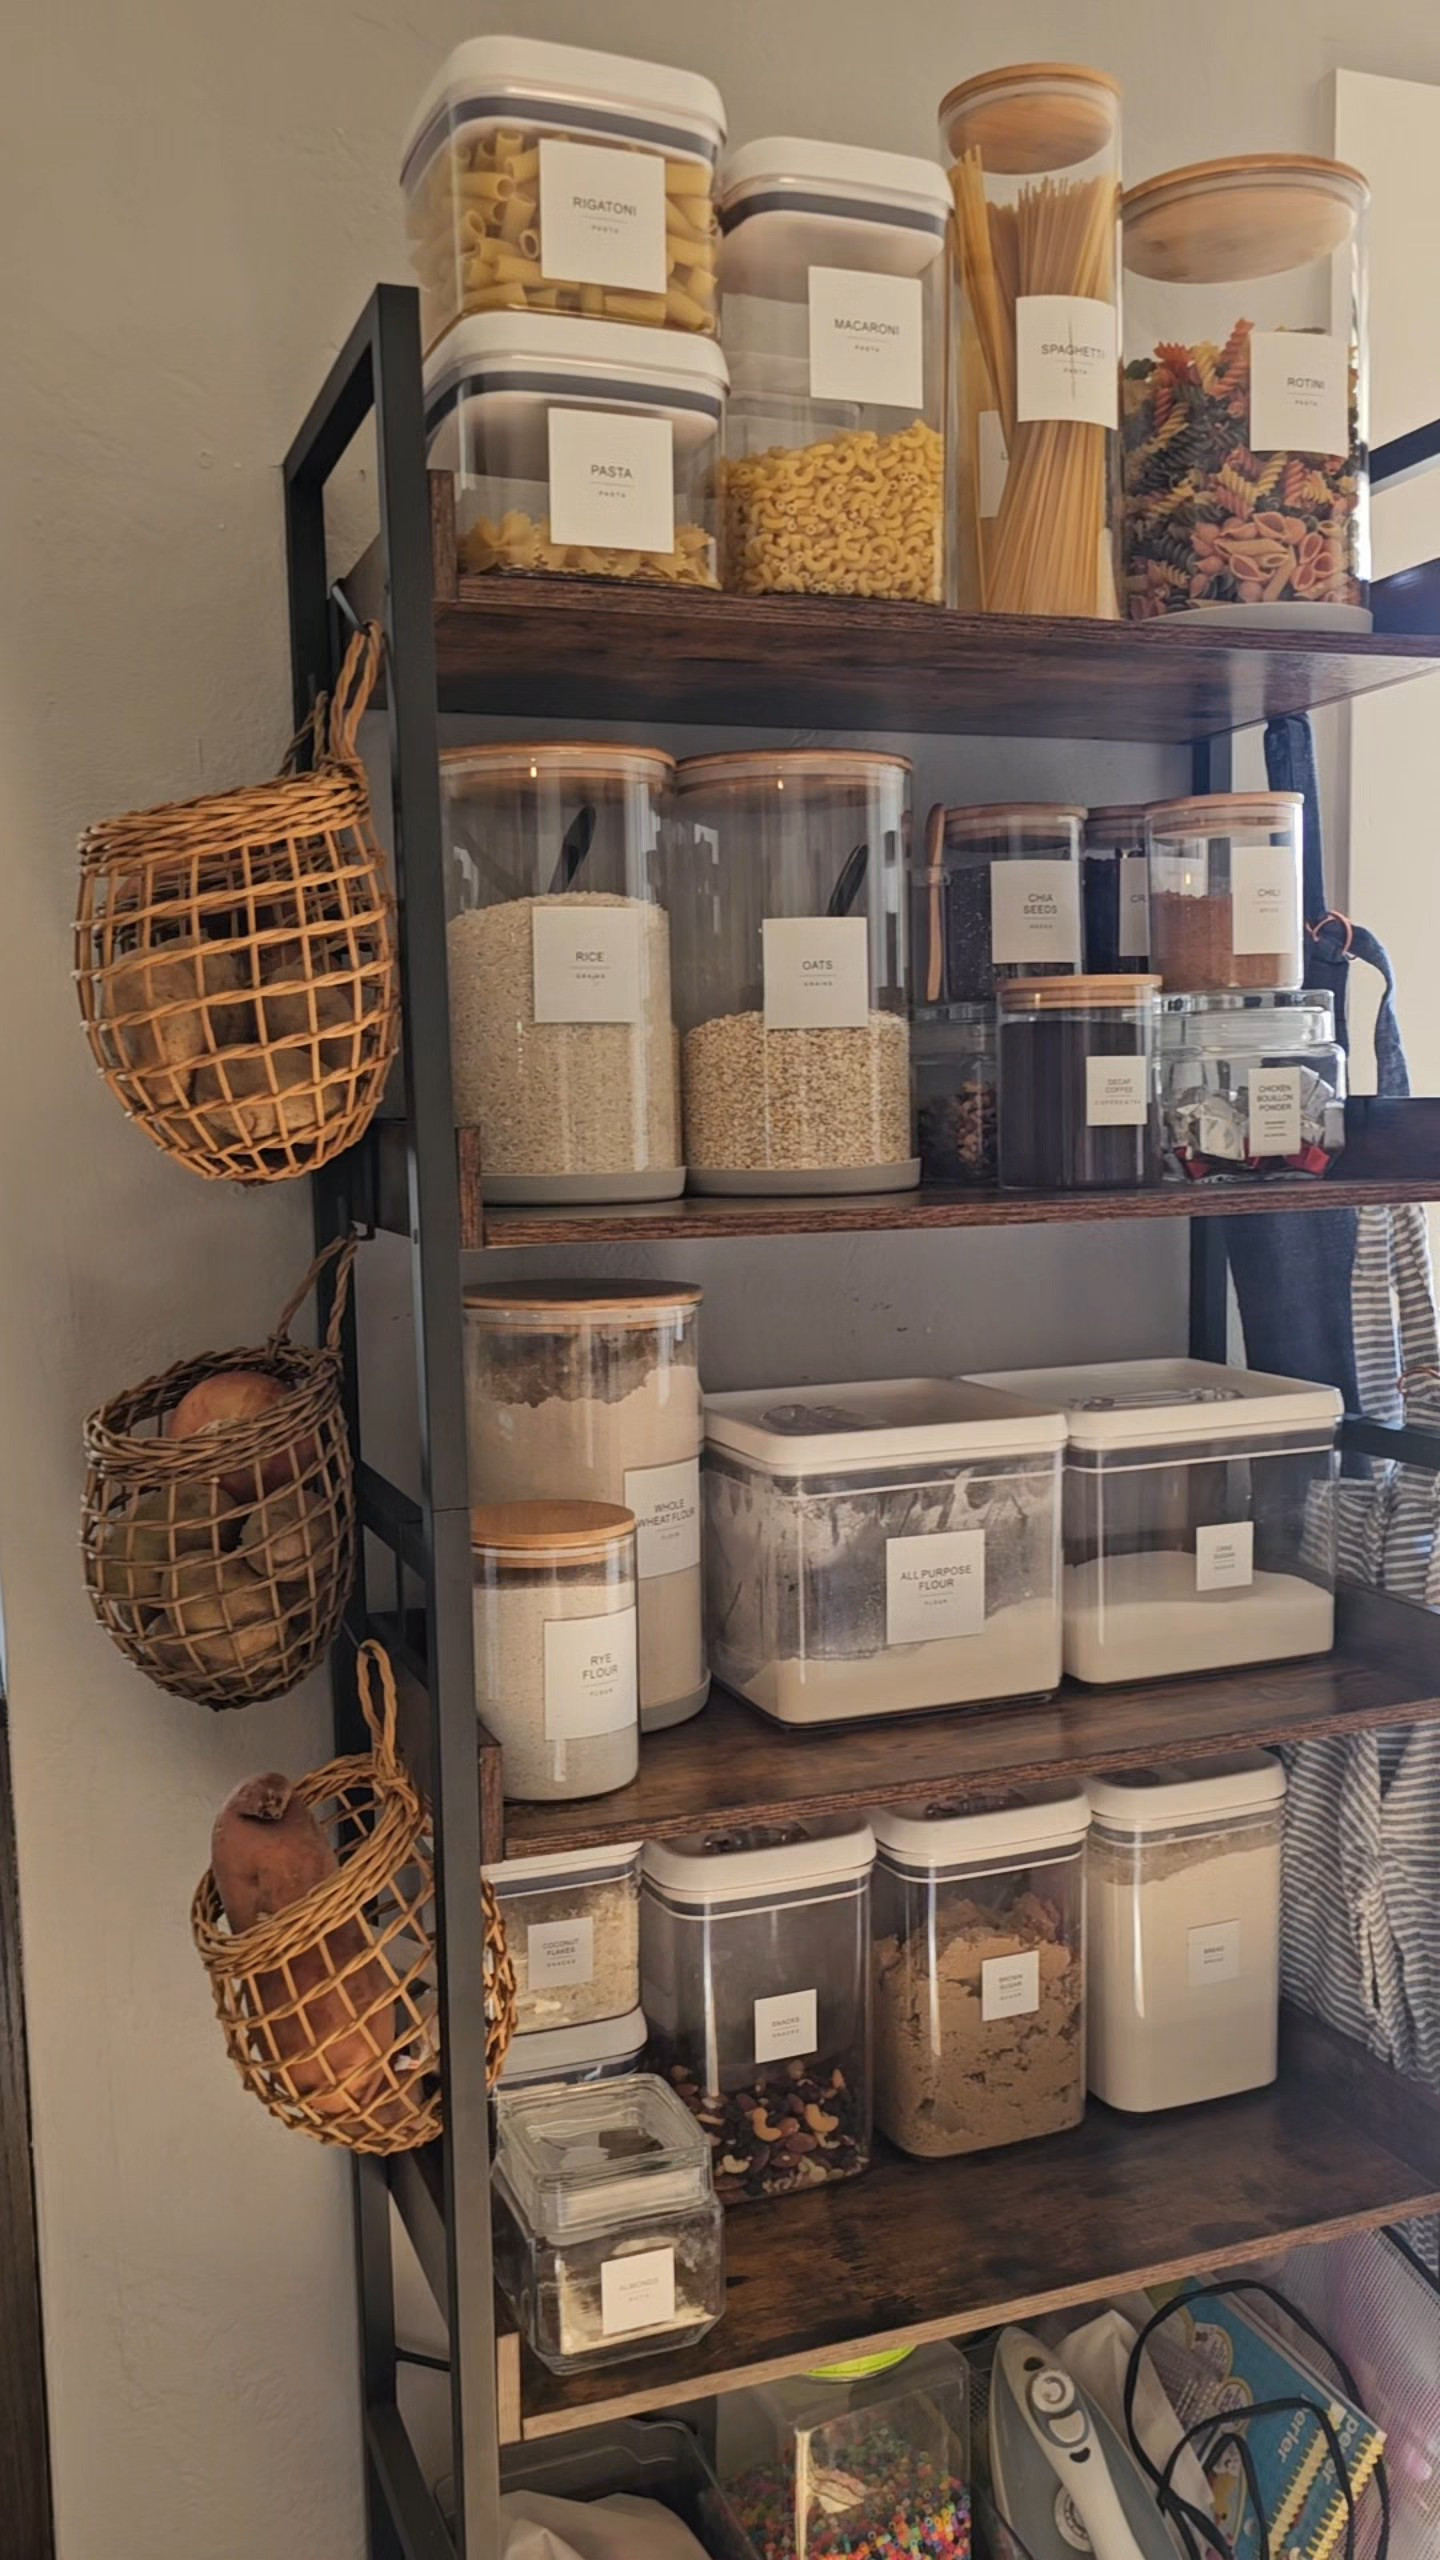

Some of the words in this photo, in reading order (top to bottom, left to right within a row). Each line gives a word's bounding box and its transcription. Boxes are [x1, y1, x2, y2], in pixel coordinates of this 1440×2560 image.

[572, 196, 637, 217] RIGATONI
[591, 225, 619, 234] PASTA
[834, 318, 900, 335] MACARONI
[854, 344, 880, 353] PASTA
[1040, 343, 1105, 360] SPAGHETTI
[1287, 377, 1325, 389] ROTINI
[590, 464, 633, 479] PASTA
[598, 490, 626, 498] PASTA
[1028, 893, 1053, 903] CHIA
[1257, 888, 1281, 897] CHILI
[1023, 905, 1058, 914] SEEDS
[576, 951, 604, 962] RICE
[802, 960, 832, 970] OATS
[1258, 1085, 1292, 1093] CHICKEN
[1257, 1094, 1293, 1102] BOUILLON
[1259, 1103, 1292, 1111] POWDER
[654, 1499, 685, 1513] WHOLE
[638, 1513, 672, 1528] WHEAT
[672, 1507, 695, 1521] FLOUR
[901, 1570, 920, 1581] ALL
[920, 1565, 972, 1579] PURPOSE
[919, 1579, 954, 1591] FLOUR
[590, 1653, 612, 1665] RYE
[582, 1665, 618, 1680] FLOUR
[542, 1938, 579, 1949] COCONUT
[546, 1947, 576, 1956] FLAKES
